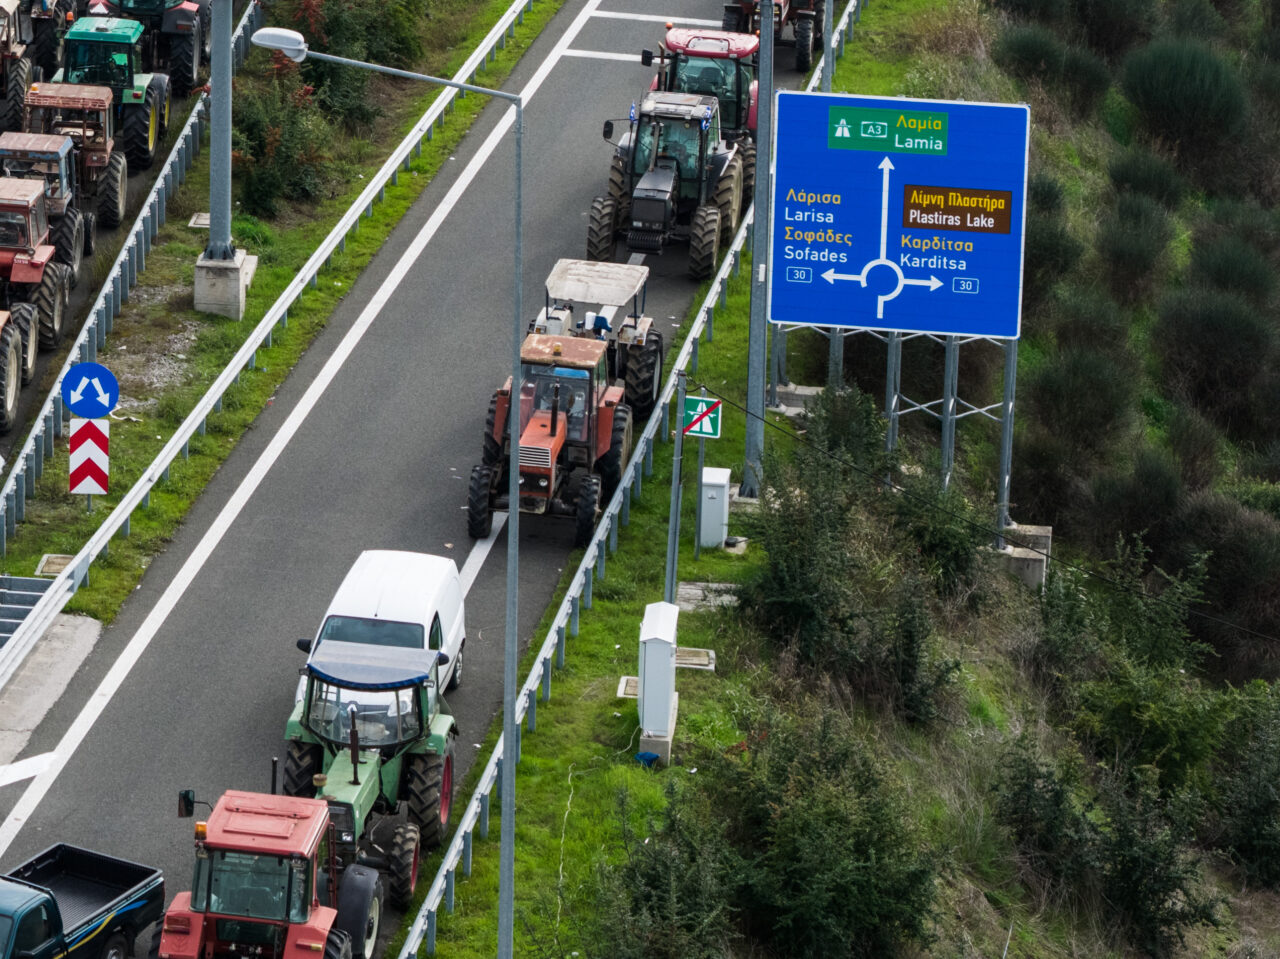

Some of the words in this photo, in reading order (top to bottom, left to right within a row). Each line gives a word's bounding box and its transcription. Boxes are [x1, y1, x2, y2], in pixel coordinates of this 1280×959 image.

[867, 125, 882, 135] A3
[896, 115, 942, 132] Λαμία
[895, 135, 943, 150] Lamia
[786, 188, 841, 205] Λάρισα
[910, 190, 945, 208] Λίμνη
[948, 193, 1005, 212] Πλαστήρα
[785, 208, 834, 223] Larisa
[909, 210, 961, 226] Plastiras
[966, 213, 995, 228] Lake
[784, 227, 853, 246] Σοφάδες
[901, 235, 973, 252] Καρδίτσα
[784, 246, 848, 263] Sofades
[900, 254, 967, 270] Karditsa
[793, 270, 806, 280] 30
[959, 280, 972, 290] 30
